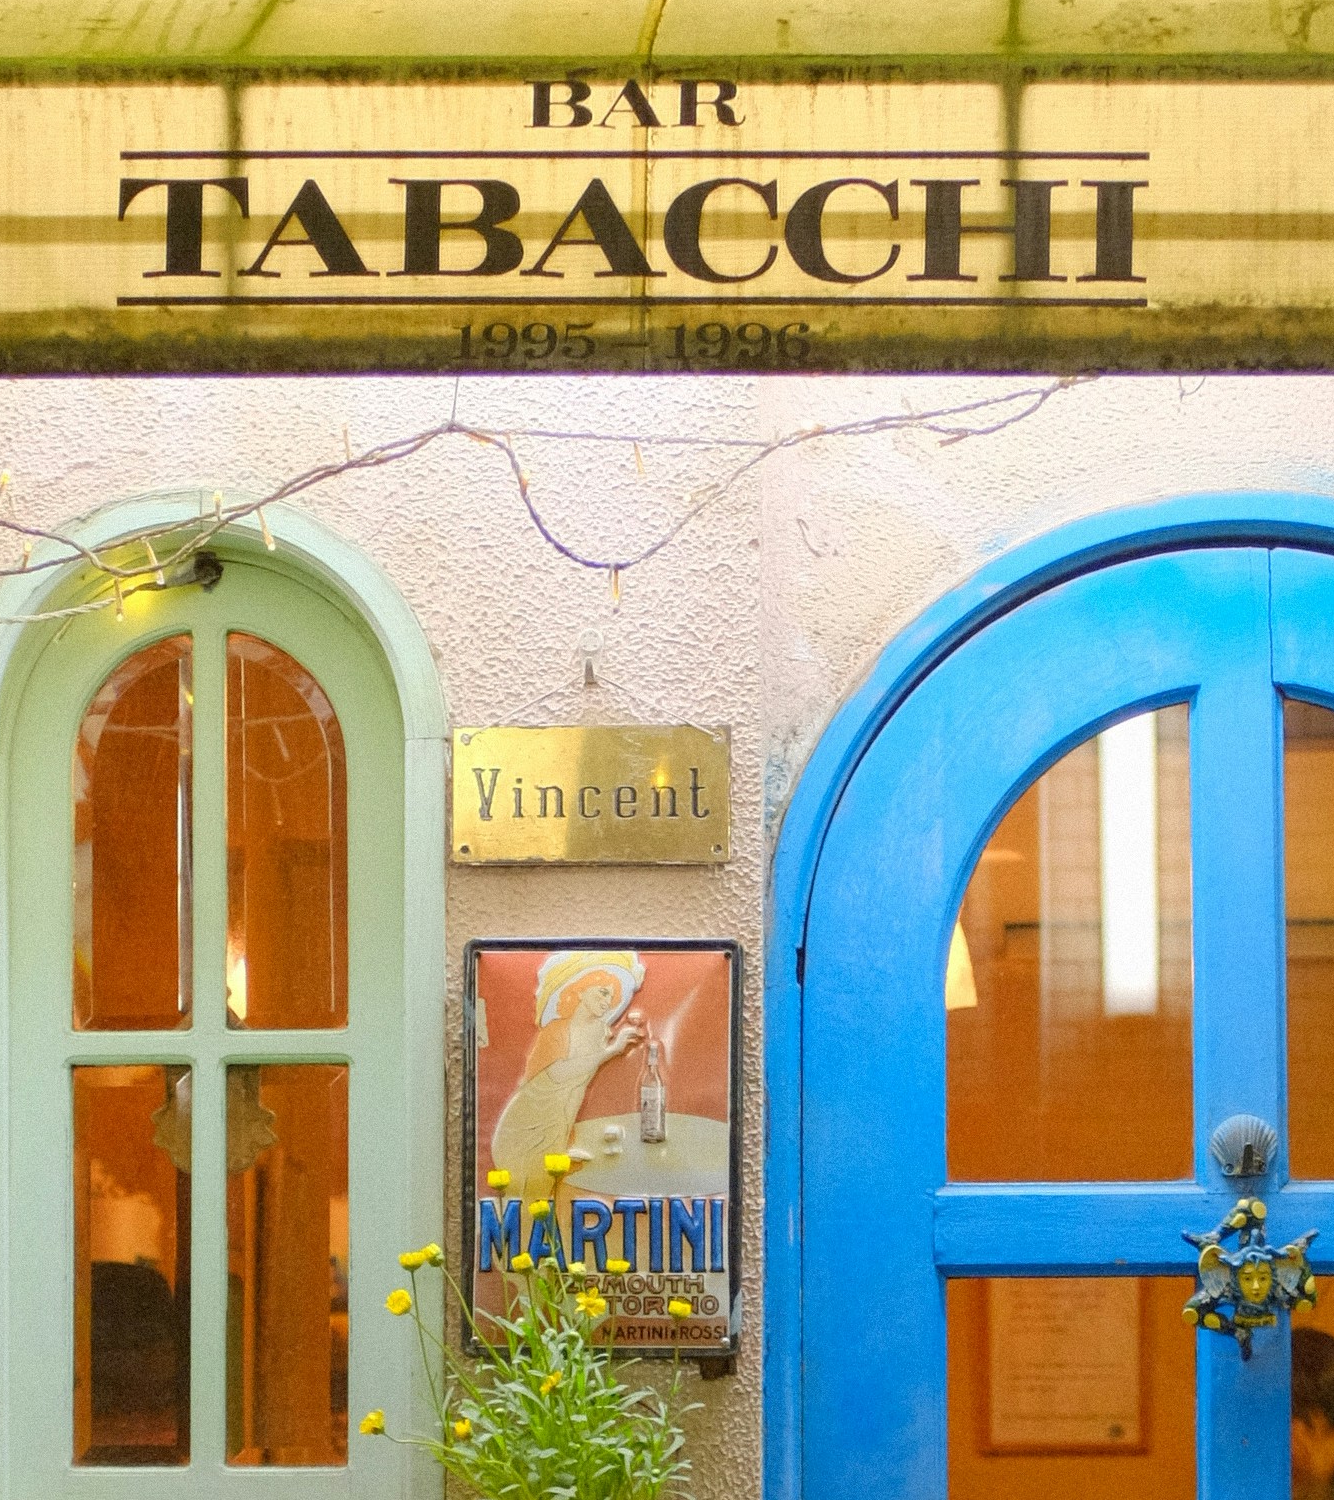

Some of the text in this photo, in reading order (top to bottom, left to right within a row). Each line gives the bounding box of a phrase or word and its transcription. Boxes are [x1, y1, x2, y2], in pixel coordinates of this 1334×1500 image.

[524, 79, 746, 130] BAR
[118, 175, 1149, 285] TABACCHI
[452, 322, 596, 361] 1995
[666, 322, 812, 361] 1996
[472, 766, 710, 821] Vincent
[479, 1198, 725, 1273] MARTINI
[605, 1295, 720, 1316] TORNO
